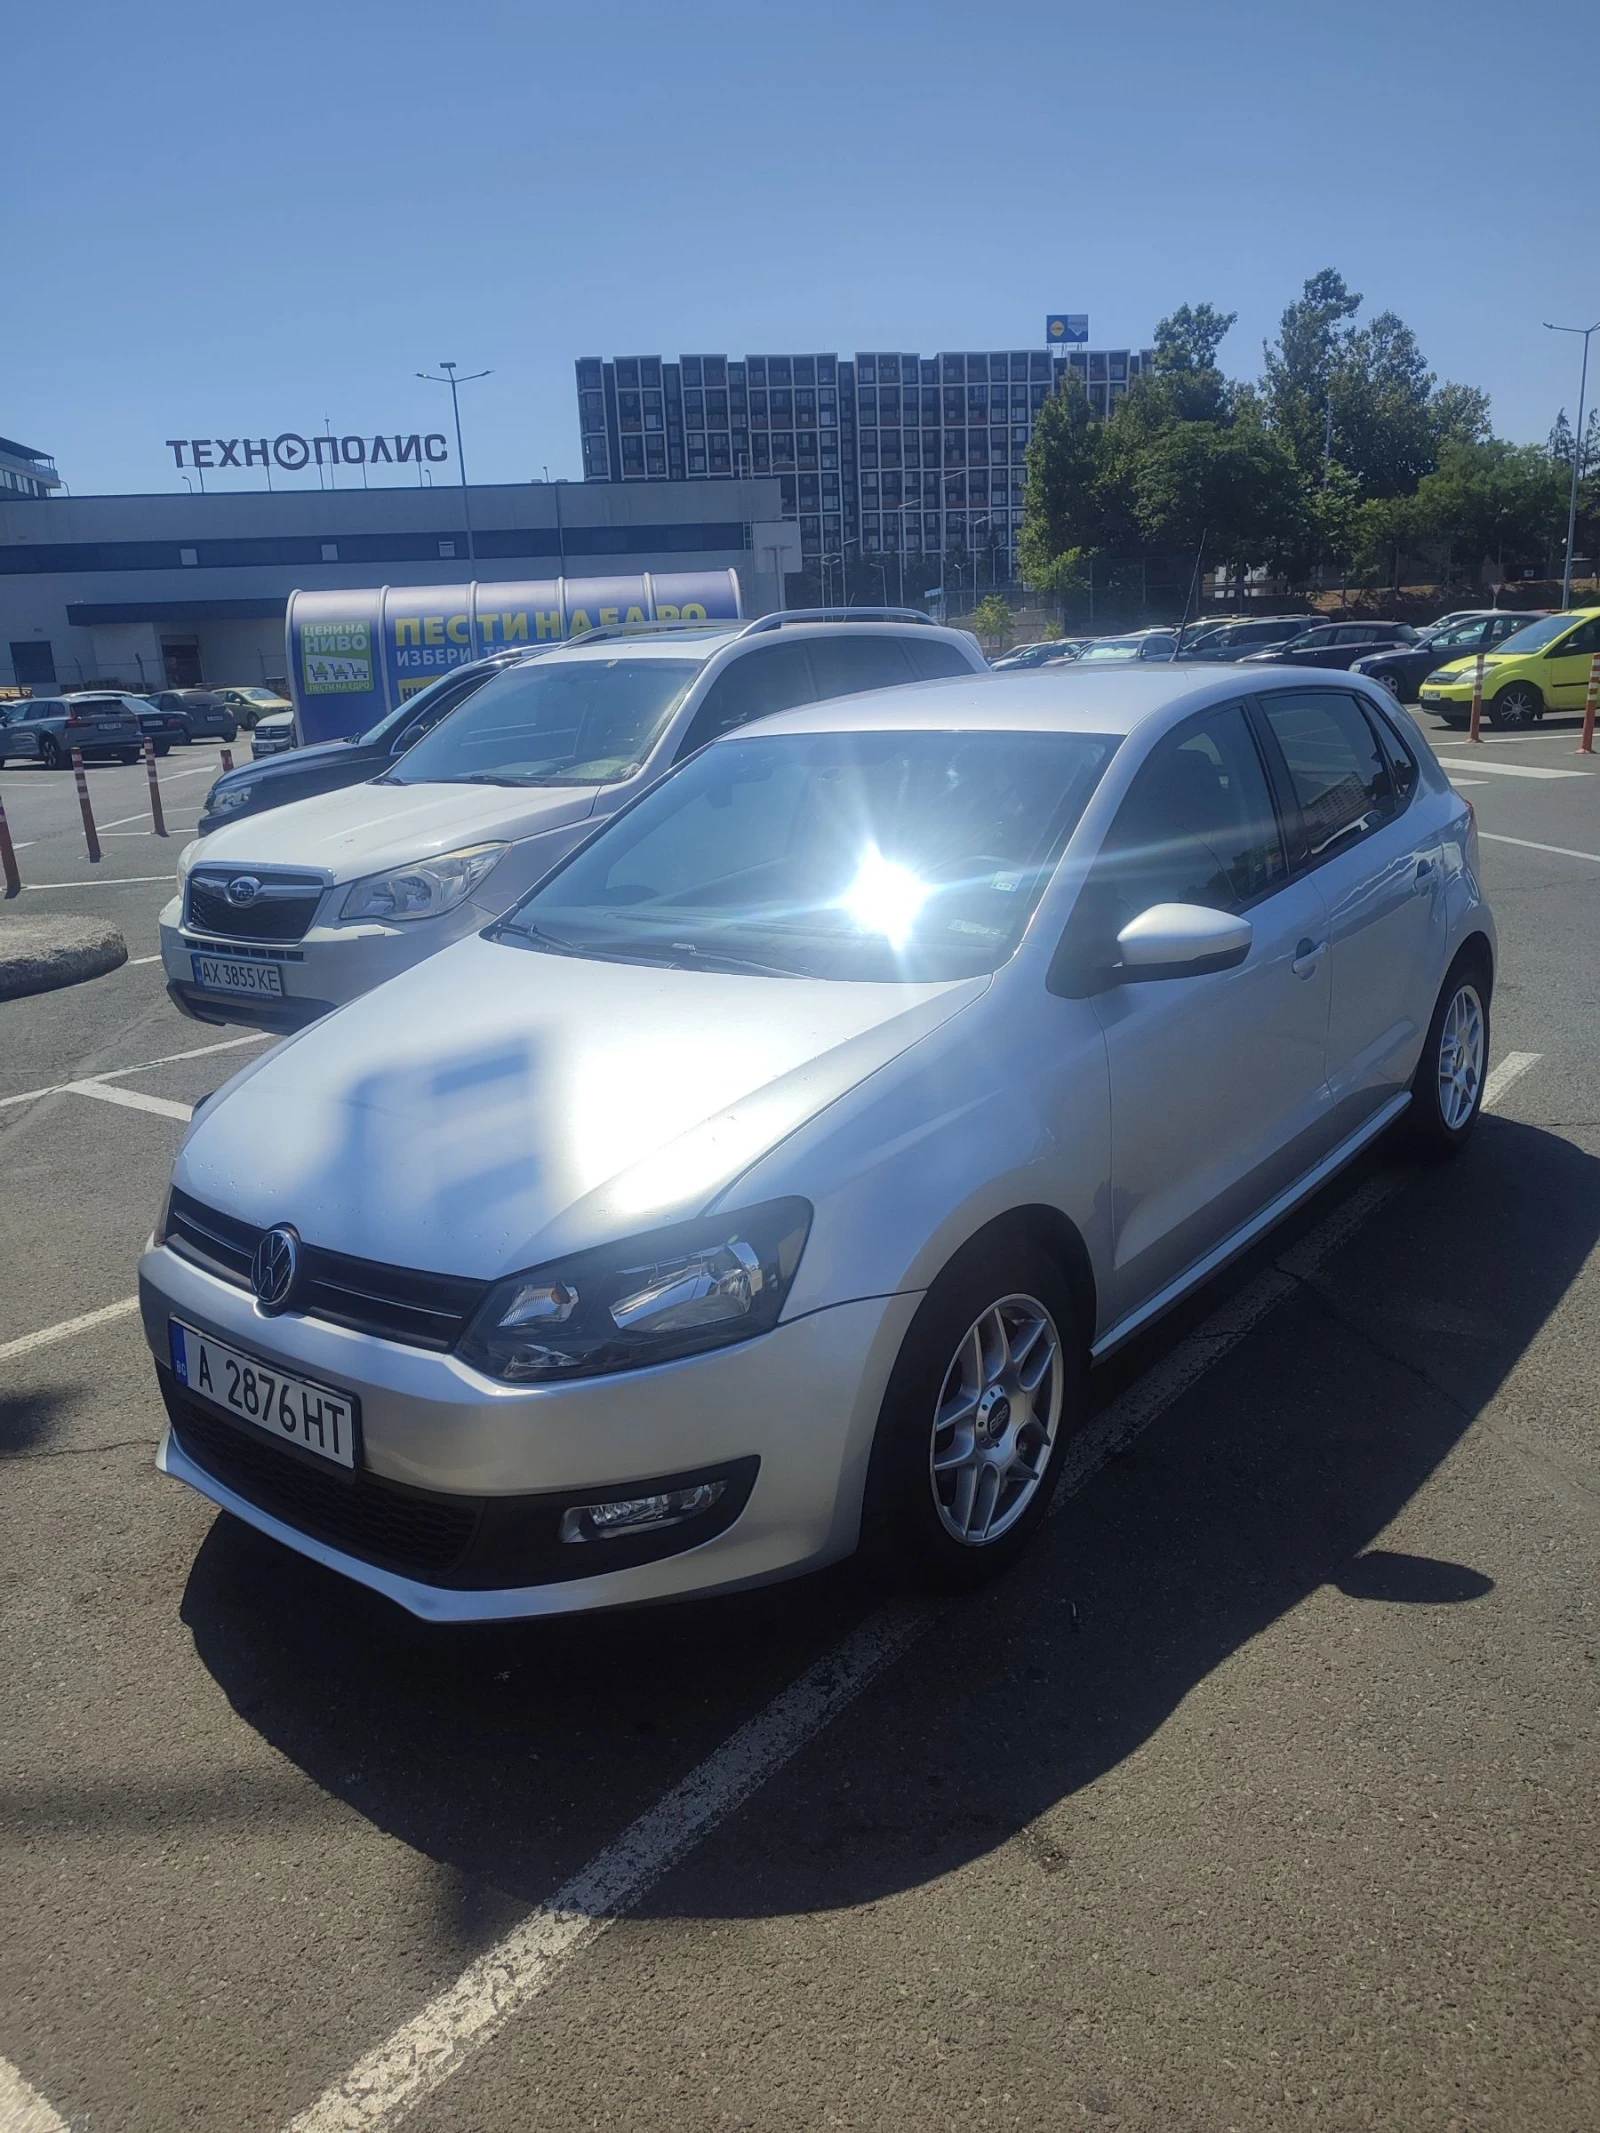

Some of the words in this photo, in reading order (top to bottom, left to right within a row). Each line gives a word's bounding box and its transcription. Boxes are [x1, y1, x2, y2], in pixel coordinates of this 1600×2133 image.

[166, 433, 447, 471] ТЕХНОПОЛИС
[304, 625, 342, 637] ЦЕНИ
[345, 624, 366, 634] НА
[395, 612, 529, 646] ПЕСТИ
[535, 608, 592, 638] НА
[304, 634, 368, 653] НИВО
[396, 647, 472, 667] ИЗБЕРИ
[309, 684, 335, 692] ПЕСТИ
[348, 681, 370, 691] ЕДРО
[203, 962, 222, 984] AX
[222, 964, 256, 989] 3855
[256, 968, 280, 992] KE
[176, 1359, 187, 1377] BG
[199, 1345, 214, 1394] A
[225, 1359, 297, 1433] 2876
[302, 1391, 345, 1455] HT
